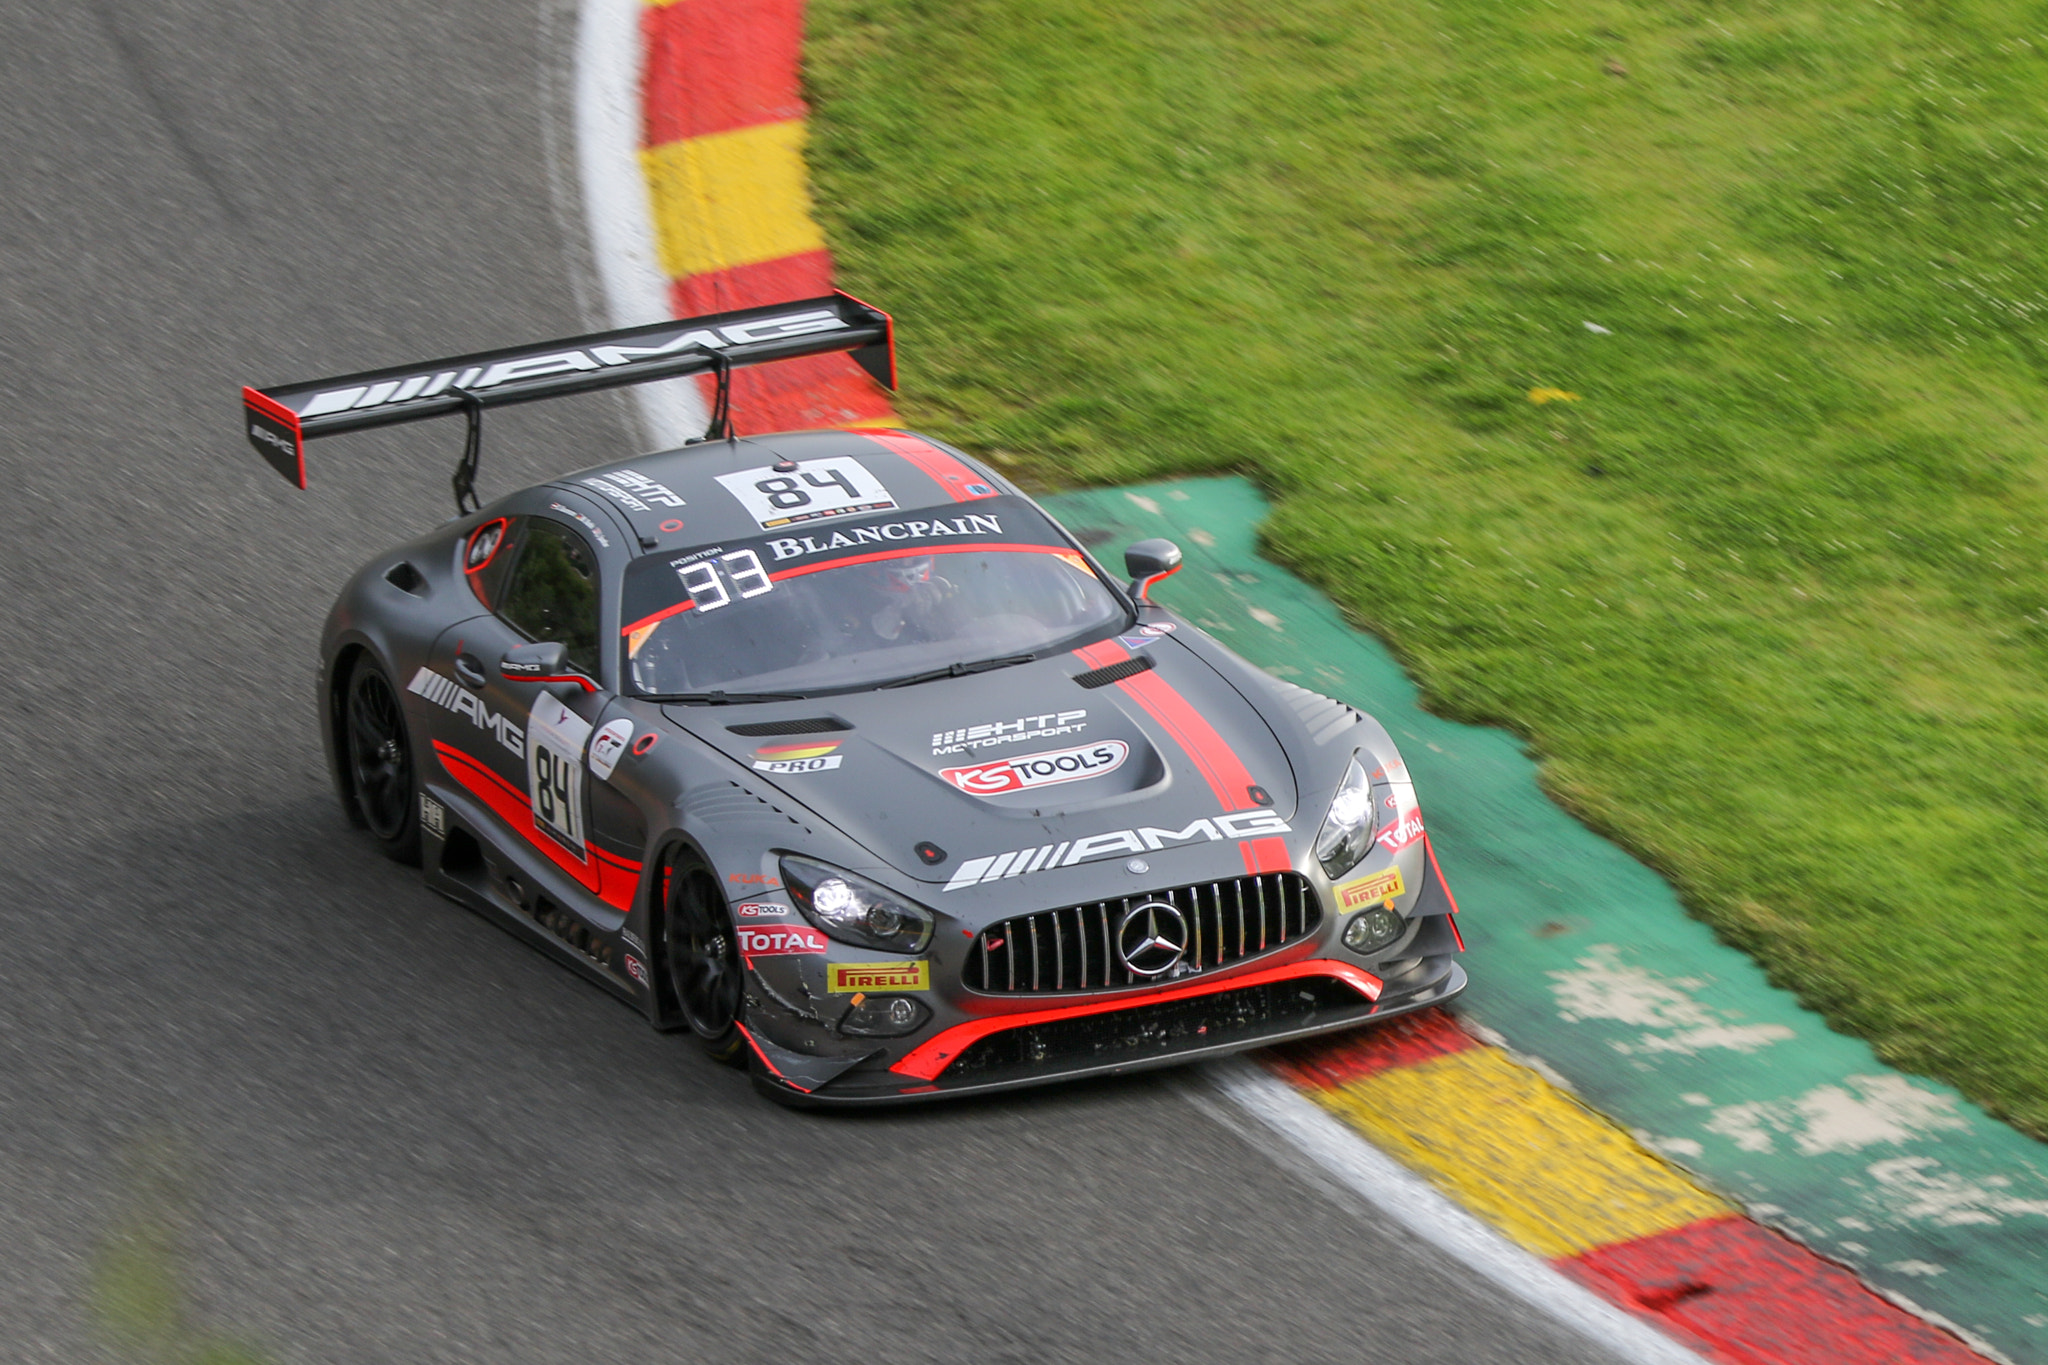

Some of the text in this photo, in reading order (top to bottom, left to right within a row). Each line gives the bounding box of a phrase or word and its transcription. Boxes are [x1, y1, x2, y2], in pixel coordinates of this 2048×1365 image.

[754, 468, 862, 510] 84
[669, 545, 723, 568] POSITION
[676, 549, 774, 613] 33
[450, 686, 525, 760] AMG
[932, 722, 1088, 756] MOTORSPORT
[768, 758, 827, 772] PRO
[536, 744, 573, 836] 84
[1061, 808, 1293, 866] AMG
[1376, 816, 1425, 848] TOTAL
[728, 873, 780, 887] KUKA
[1340, 873, 1400, 908] PIRELLI
[737, 930, 825, 951] TOTAL
[837, 966, 921, 987] PIRELLI
